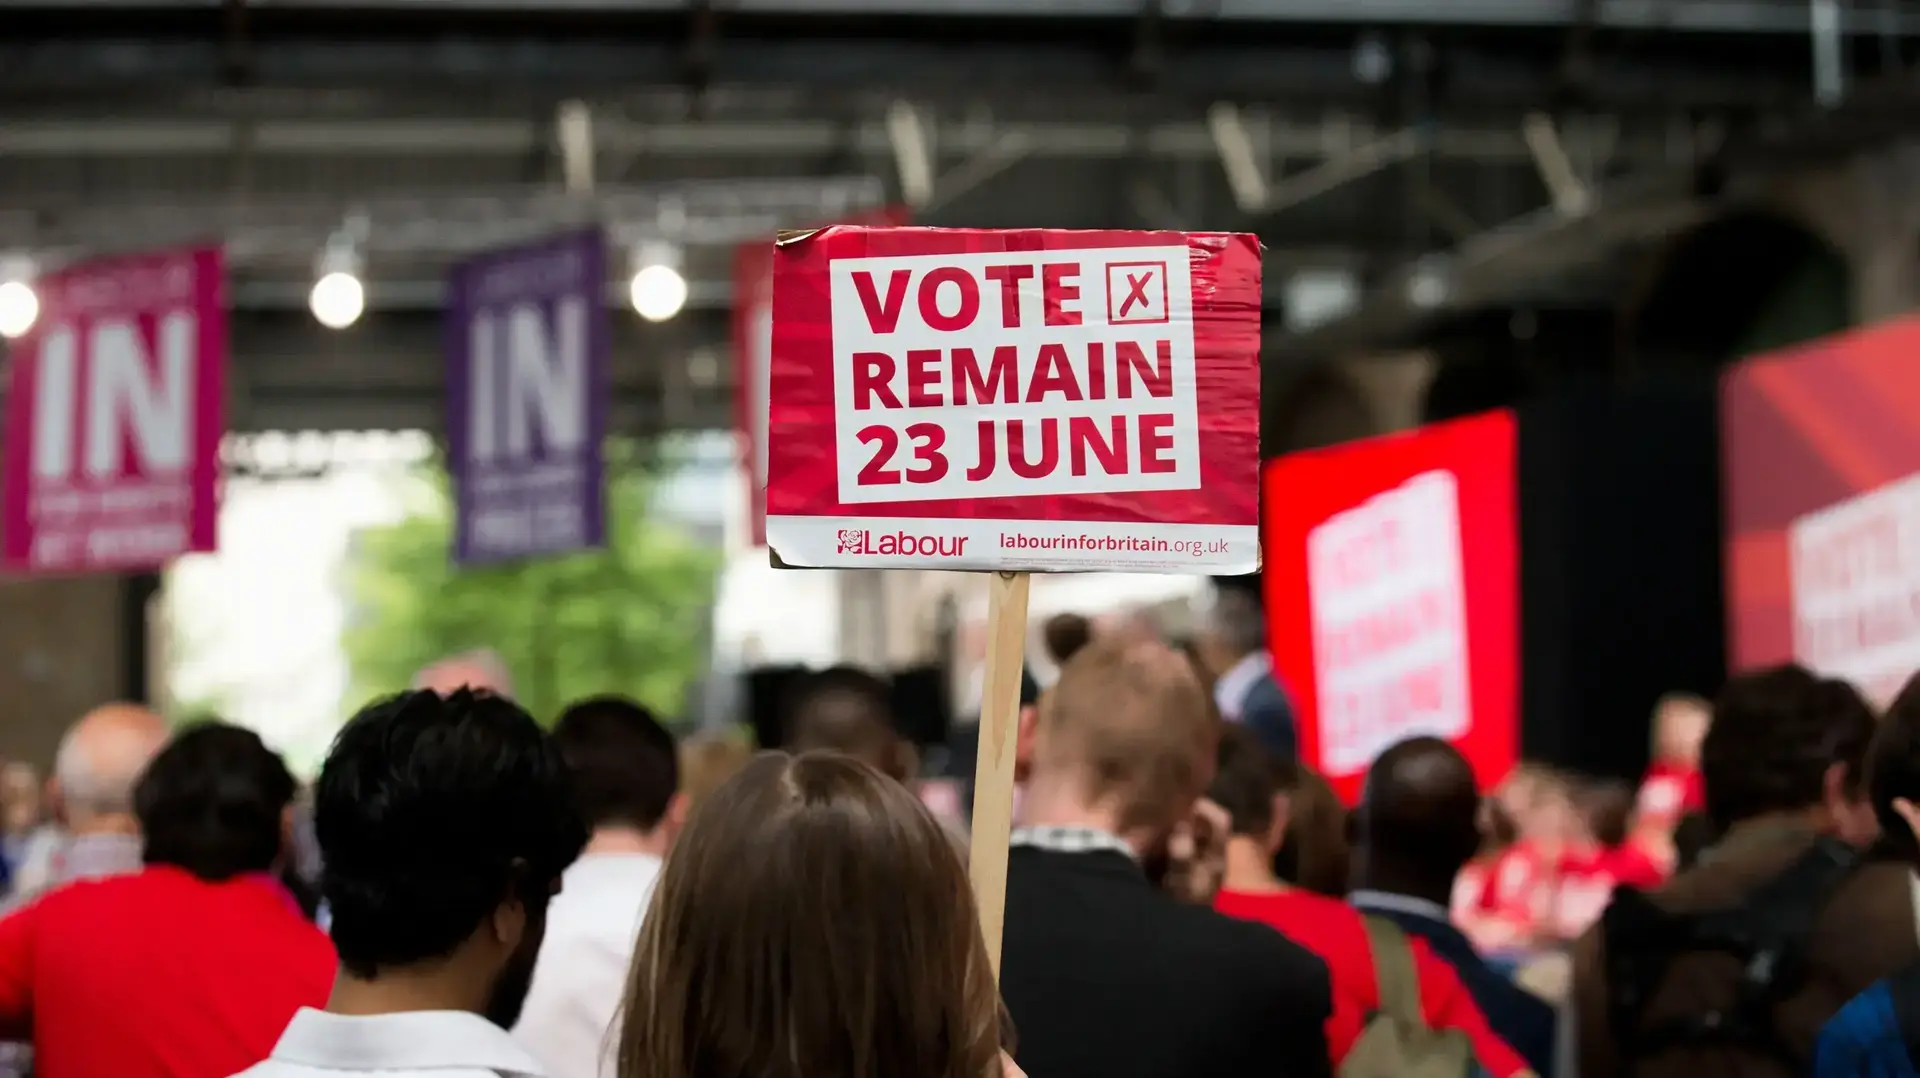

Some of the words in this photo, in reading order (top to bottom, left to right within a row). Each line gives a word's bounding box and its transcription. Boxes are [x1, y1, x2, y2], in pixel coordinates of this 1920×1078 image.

[851, 262, 1083, 335] VOTE
[37, 313, 193, 478] IN
[470, 297, 588, 457] IN
[851, 340, 1173, 410] REMAIN
[856, 421, 949, 487] 23
[966, 413, 1177, 483] JUNE
[864, 530, 969, 557] Labour
[999, 532, 1229, 557] labourinforbritain.org.uk
